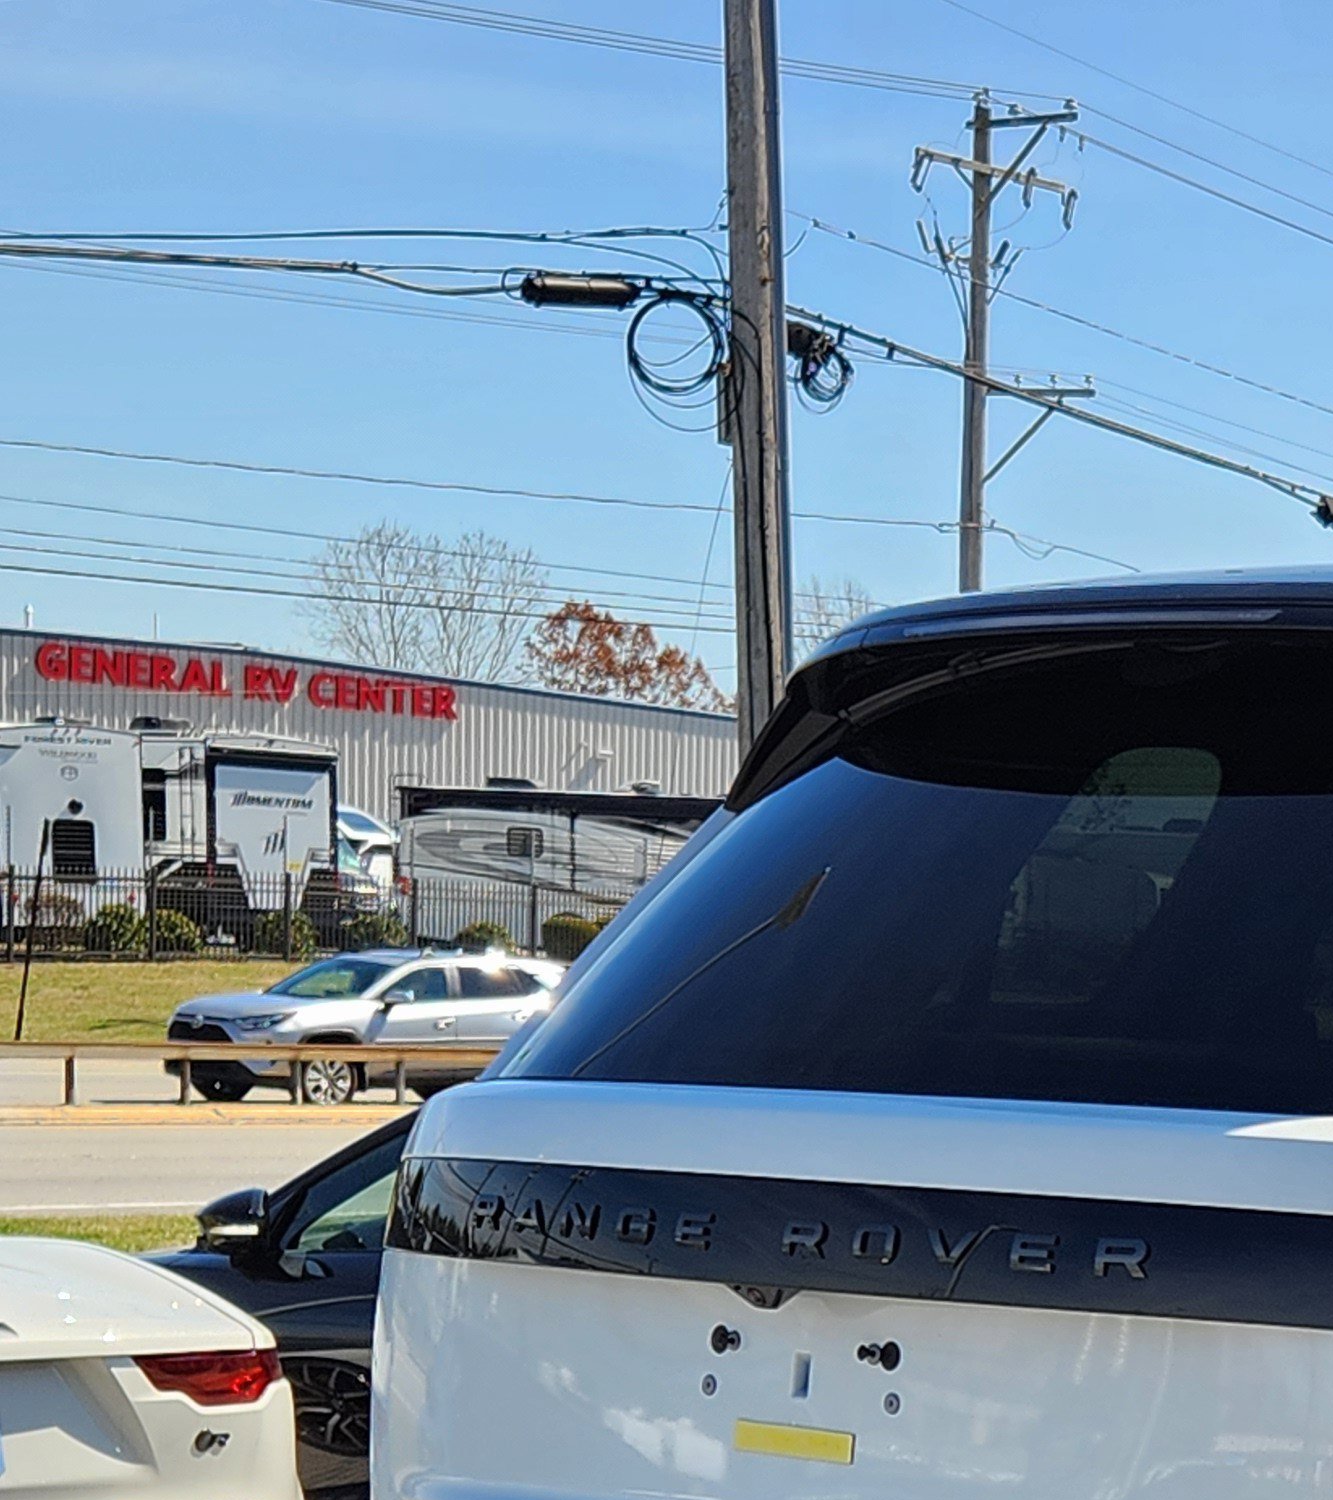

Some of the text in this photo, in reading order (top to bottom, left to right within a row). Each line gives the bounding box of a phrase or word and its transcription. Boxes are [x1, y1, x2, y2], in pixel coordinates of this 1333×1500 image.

[35, 641, 458, 721] GENERAL RV CENTER
[467, 1194, 1151, 1279] RANGE ROVER
